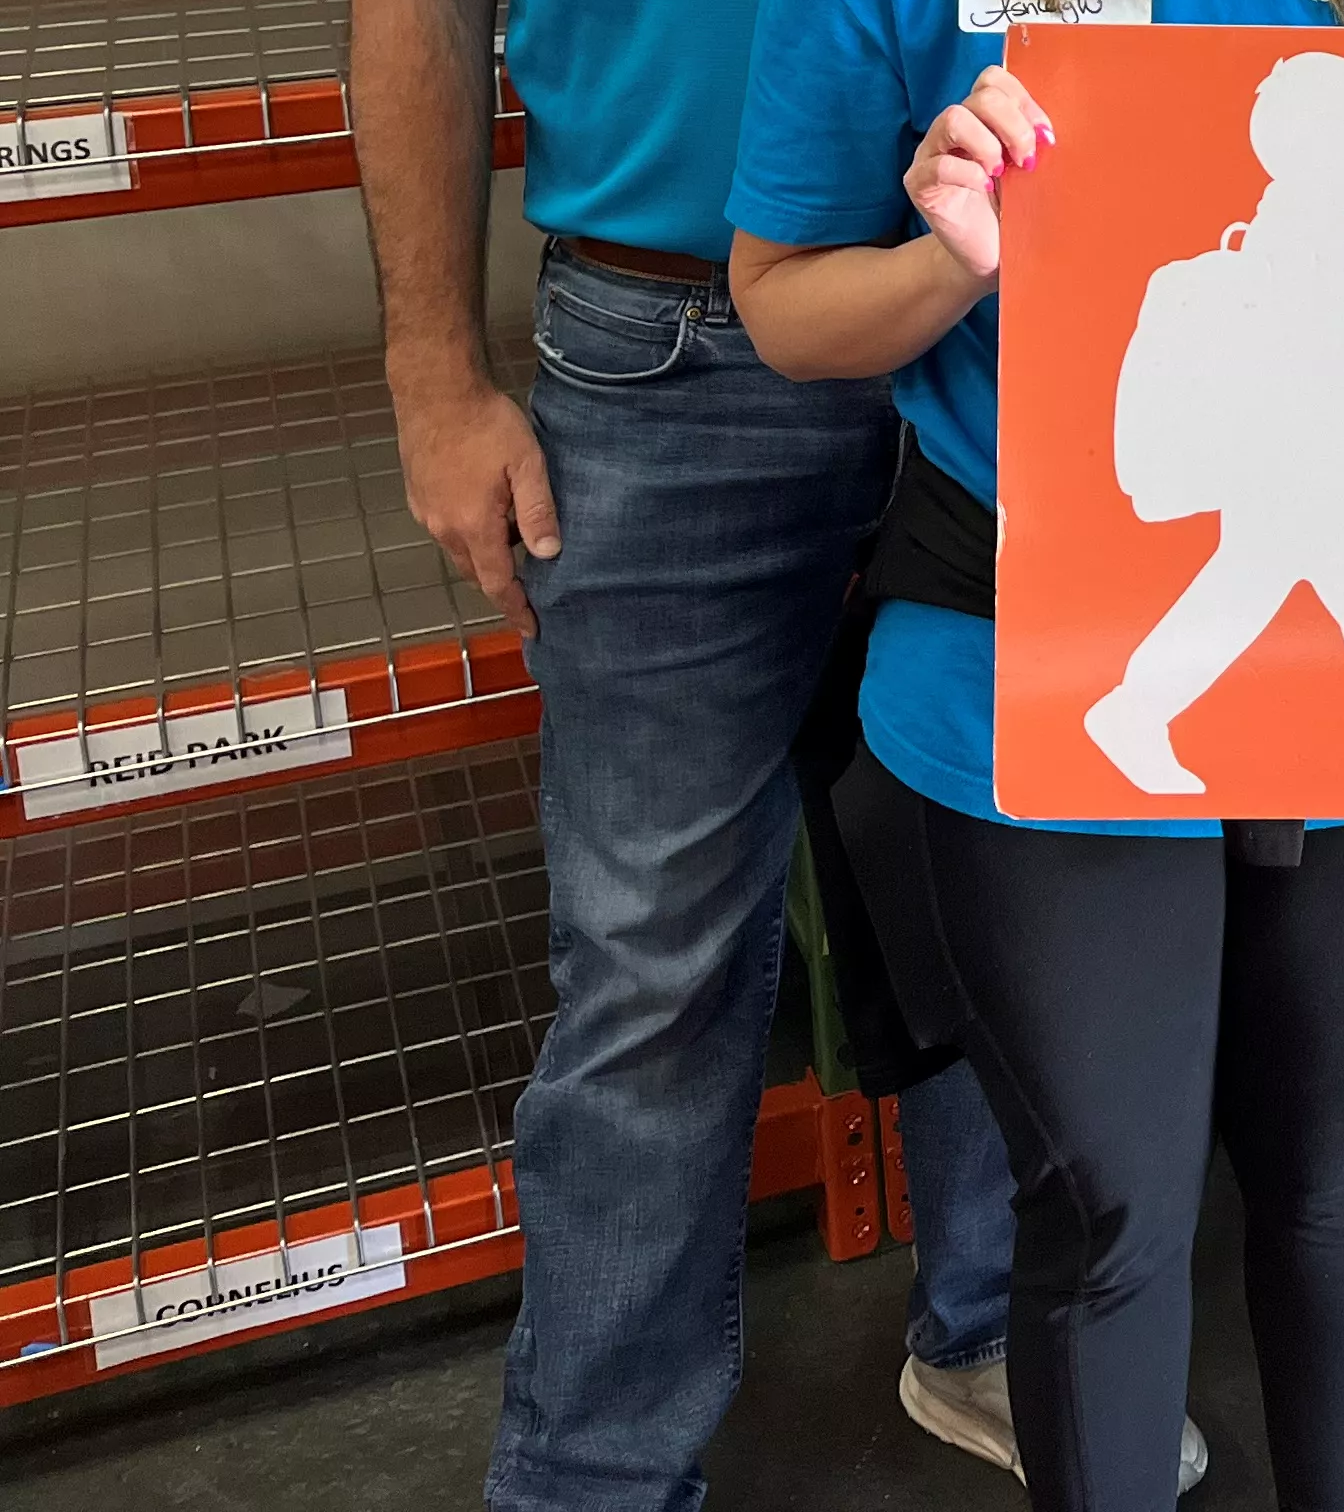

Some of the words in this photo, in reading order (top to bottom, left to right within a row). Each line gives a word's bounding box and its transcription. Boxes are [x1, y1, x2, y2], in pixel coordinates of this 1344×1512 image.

[89, 749, 173, 787] REID
[187, 725, 289, 769] PARK
[156, 1264, 345, 1328] CORNELIUS
